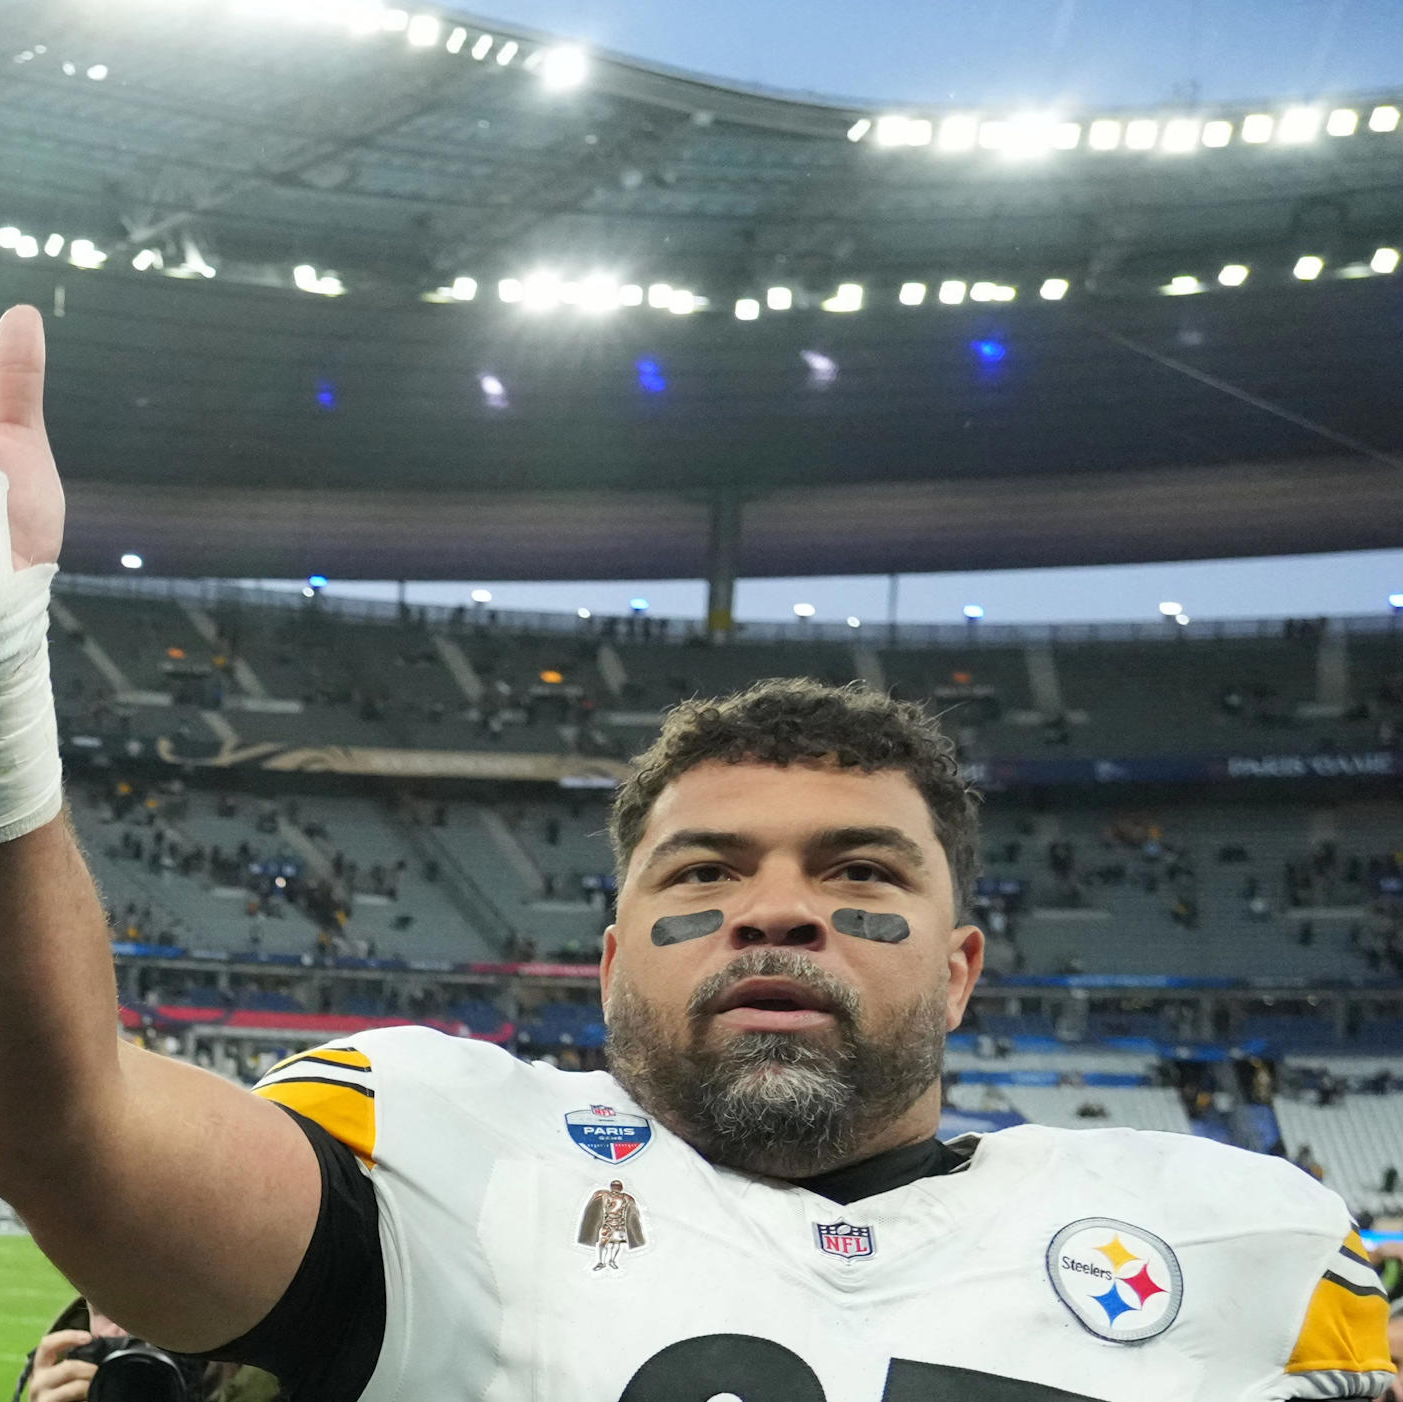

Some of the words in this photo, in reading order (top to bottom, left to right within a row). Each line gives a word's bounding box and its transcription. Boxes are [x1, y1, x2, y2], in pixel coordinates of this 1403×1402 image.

[583, 1126, 636, 1136] PARIS
[824, 1235, 868, 1254] NFL
[1061, 1255, 1113, 1281] Steelers
